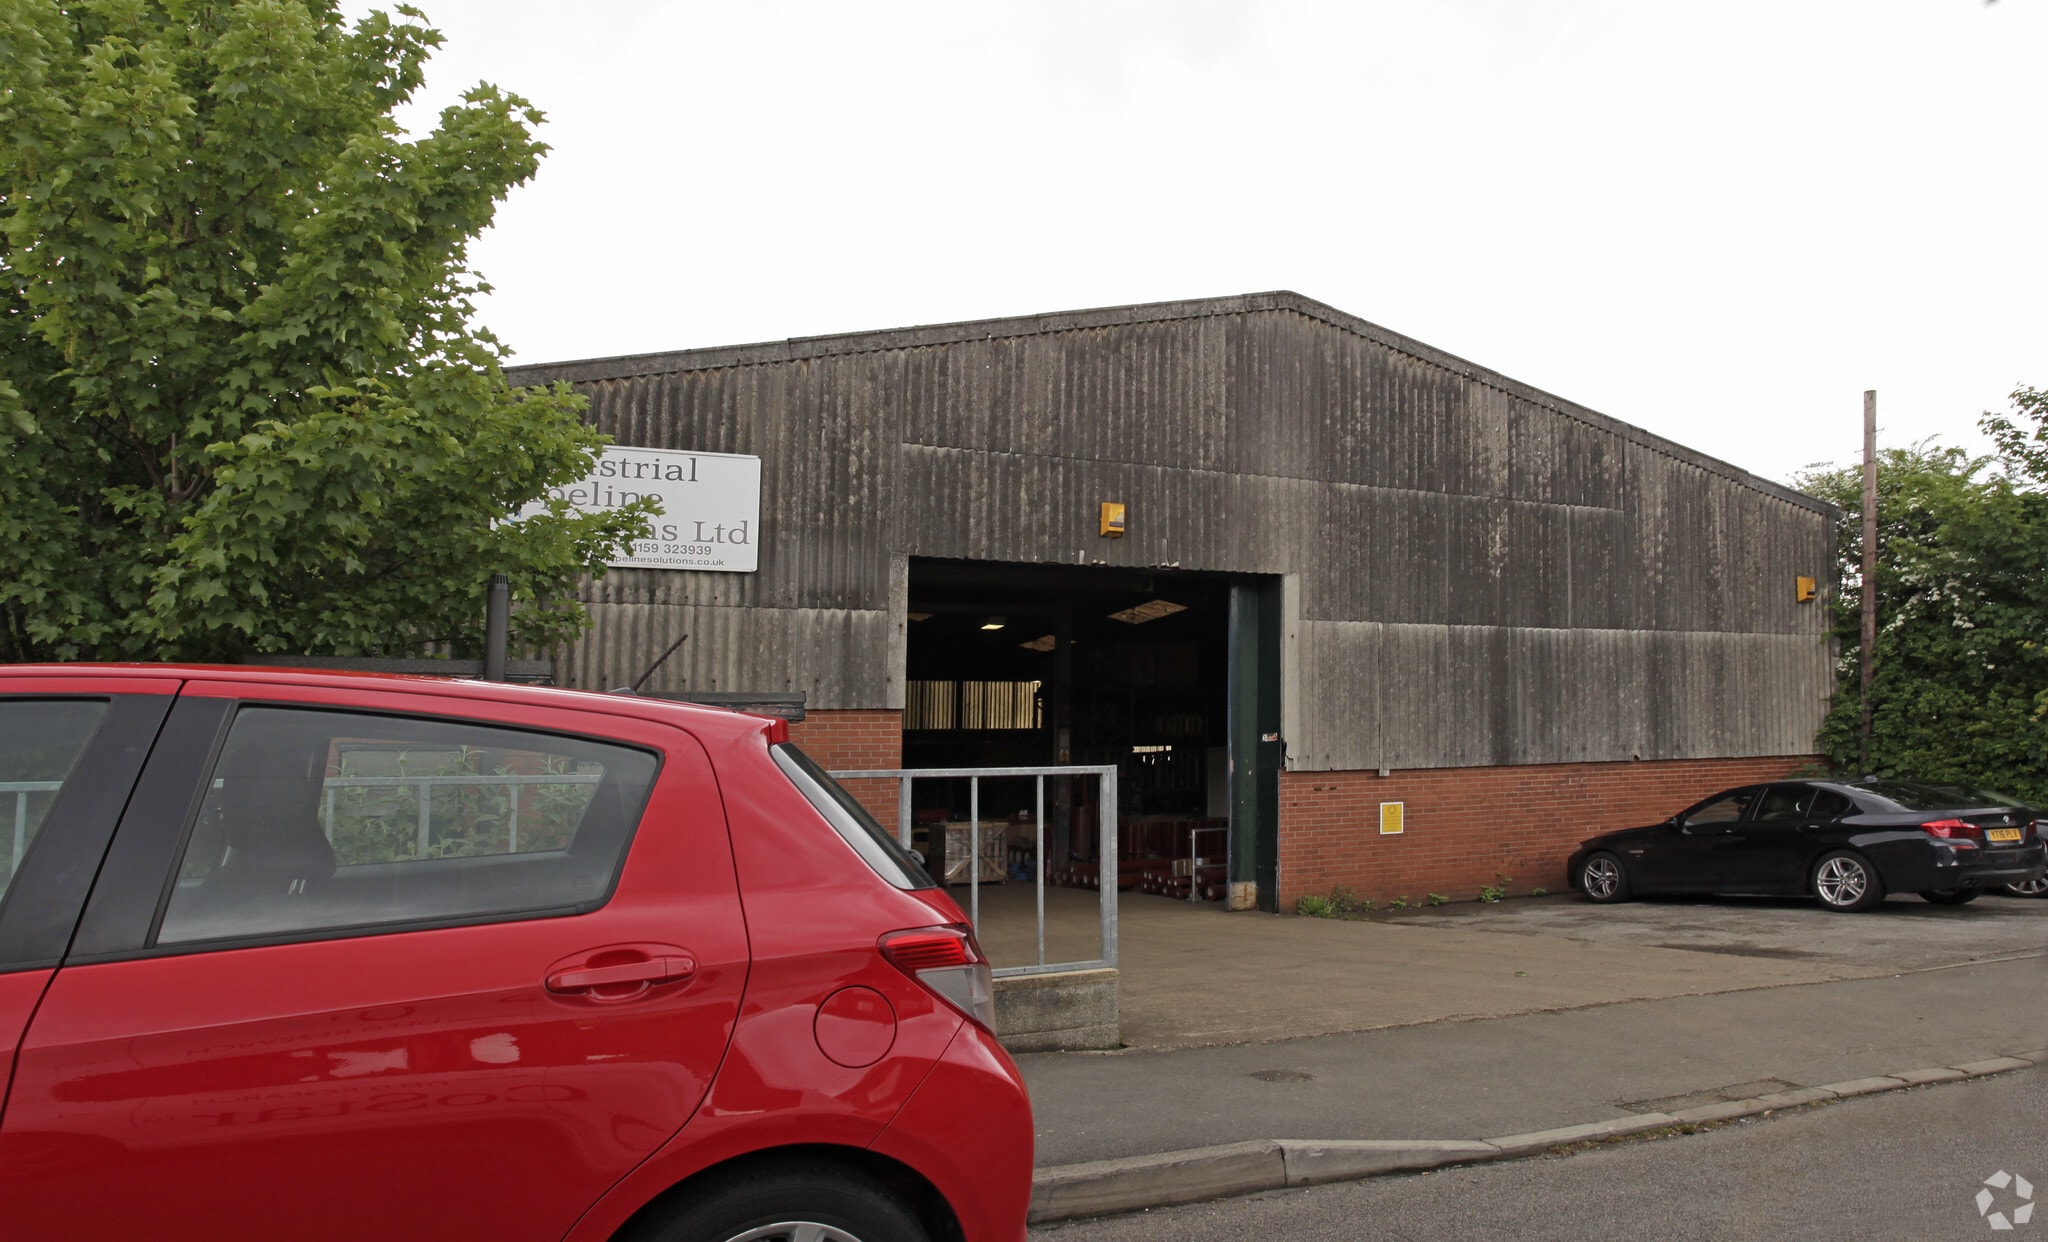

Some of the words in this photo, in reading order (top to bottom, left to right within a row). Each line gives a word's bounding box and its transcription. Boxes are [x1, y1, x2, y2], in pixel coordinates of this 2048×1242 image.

[591, 457, 699, 482] strial
[693, 520, 750, 545] Ltd
[632, 542, 659, 553] 1159
[663, 544, 712, 556] 323939
[612, 555, 724, 566] pelinesolutions.co.uk
